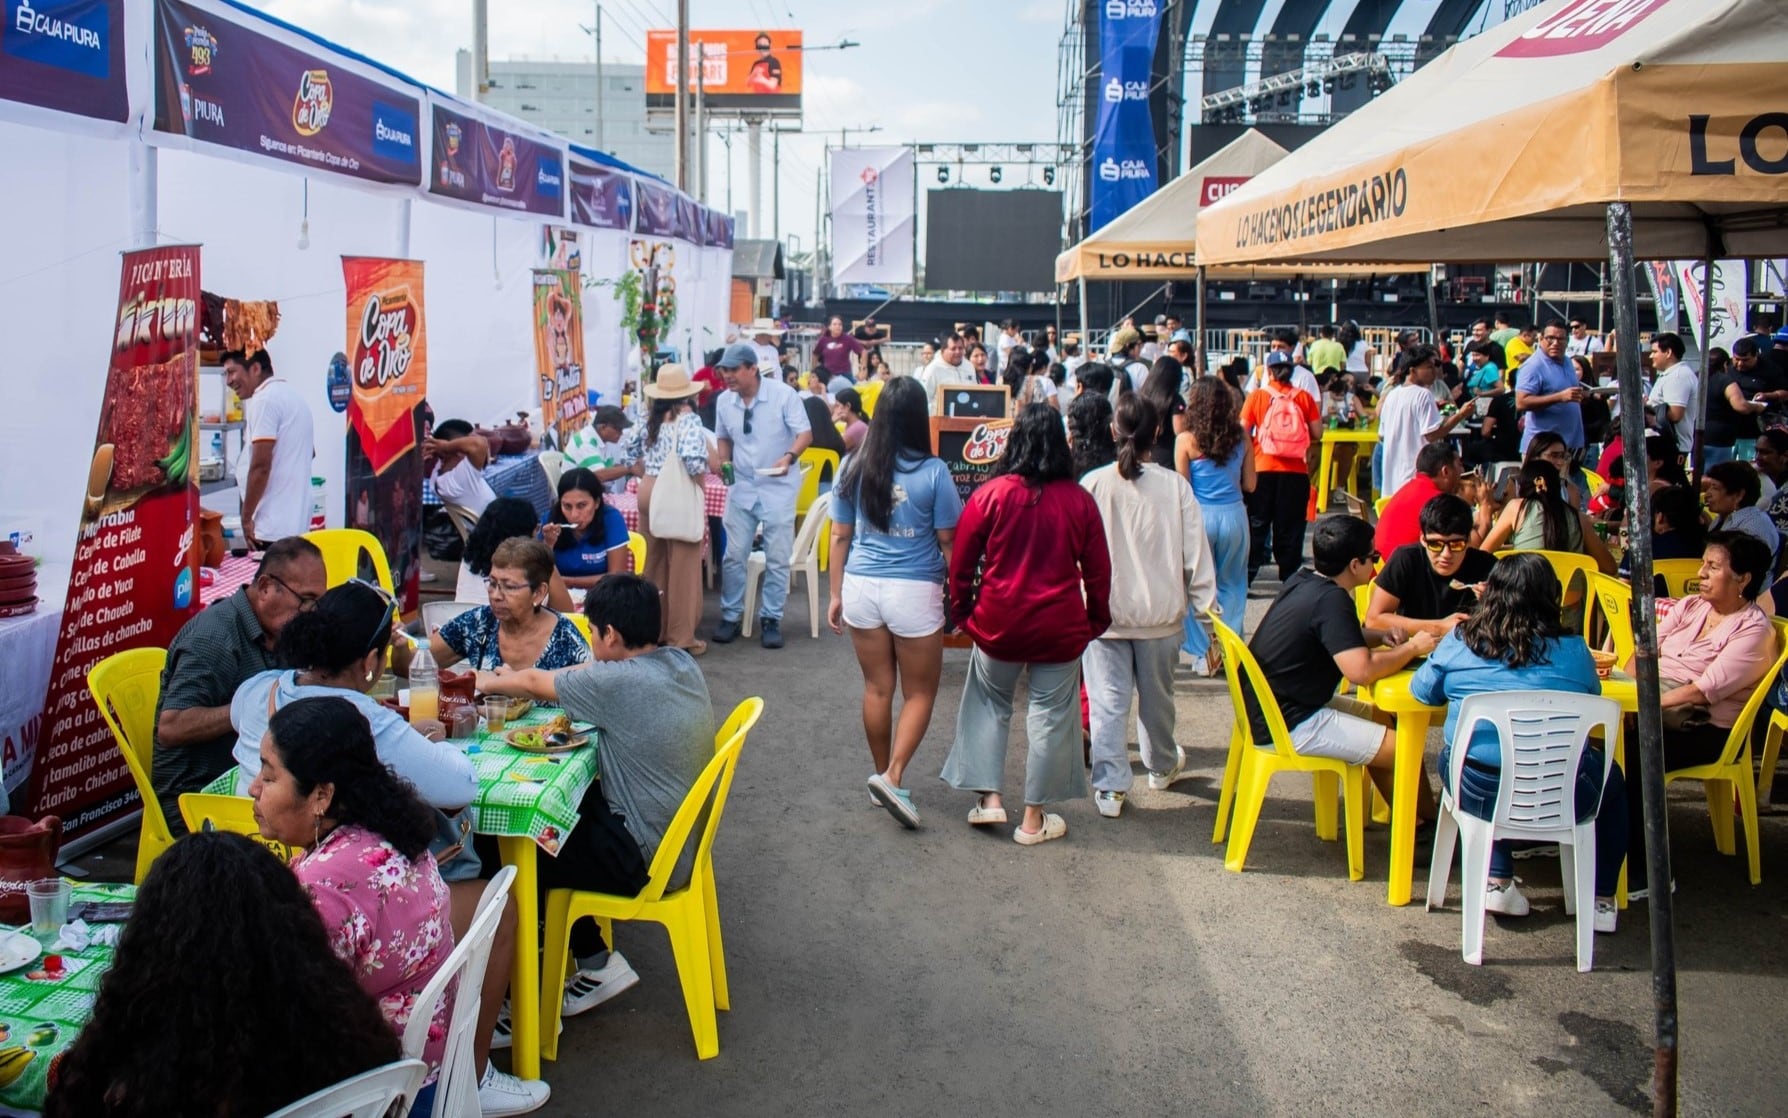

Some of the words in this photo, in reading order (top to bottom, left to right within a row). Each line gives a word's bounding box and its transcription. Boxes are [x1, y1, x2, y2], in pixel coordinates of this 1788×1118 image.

[35, 14, 63, 39] CAJA
[64, 22, 101, 50] PIURA
[192, 46, 211, 65] 493
[301, 70, 328, 102] Copa
[194, 98, 225, 127] PIURA
[298, 104, 309, 124] de
[1688, 112, 1788, 176] LO
[1121, 160, 1145, 169] CAJA
[1121, 168, 1150, 179] PIURA
[1236, 215, 1250, 248] LO
[1300, 167, 1407, 238] LEGENDARIO
[1098, 253, 1131, 269] LO
[1136, 252, 1196, 268] HACE
[362, 294, 409, 348] Copa
[360, 350, 376, 384] de
[378, 339, 411, 386] Oro
[970, 446, 985, 459] de
[102, 531, 118, 549] de
[93, 558, 109, 576] de
[97, 582, 113, 599] de
[114, 577, 134, 595] Yuca
[80, 611, 94, 629] de
[96, 600, 134, 624] Chavelo
[102, 630, 114, 648] de
[115, 617, 153, 642] chancho
[70, 735, 85, 753] de
[49, 754, 97, 783] tamalito
[40, 785, 78, 812] Clarito
[85, 769, 119, 793] Chicha
[80, 799, 123, 824] Francisco
